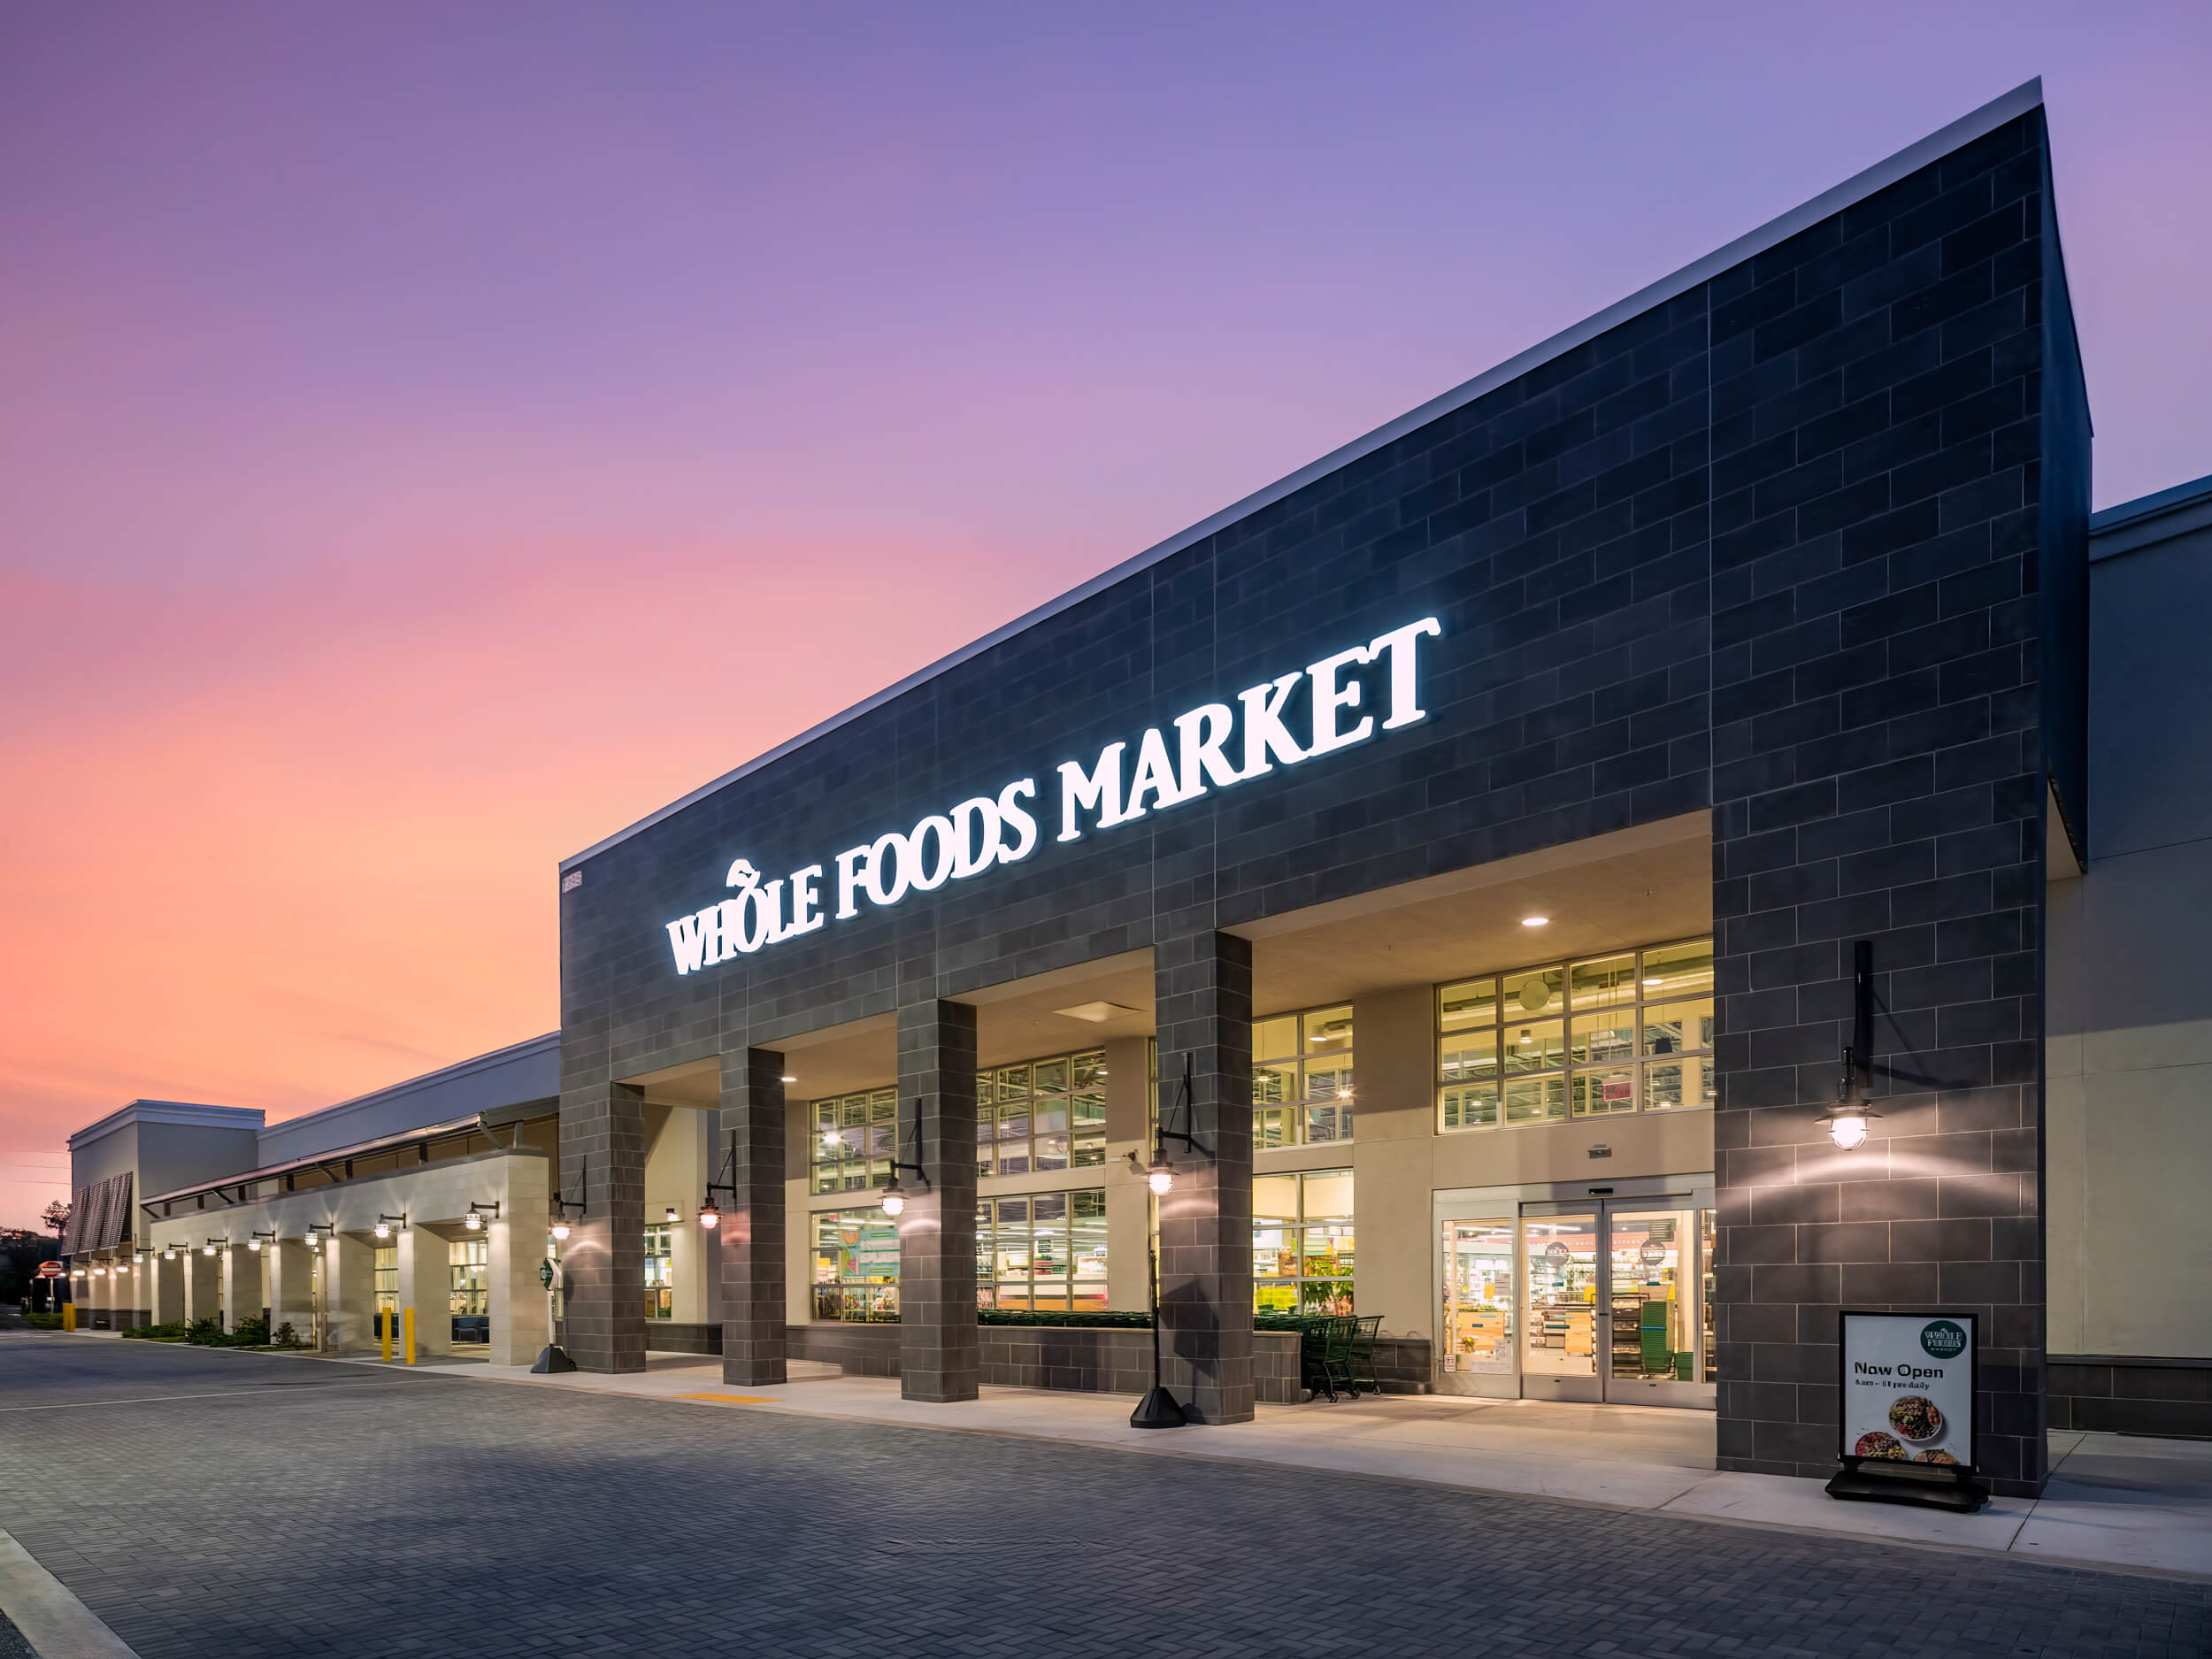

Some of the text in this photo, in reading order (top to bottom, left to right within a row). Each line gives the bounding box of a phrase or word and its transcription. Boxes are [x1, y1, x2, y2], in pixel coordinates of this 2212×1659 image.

[665, 617, 1441, 974] WHOLE FOODS MARKET
[1855, 1361, 1944, 1380] Now Open
